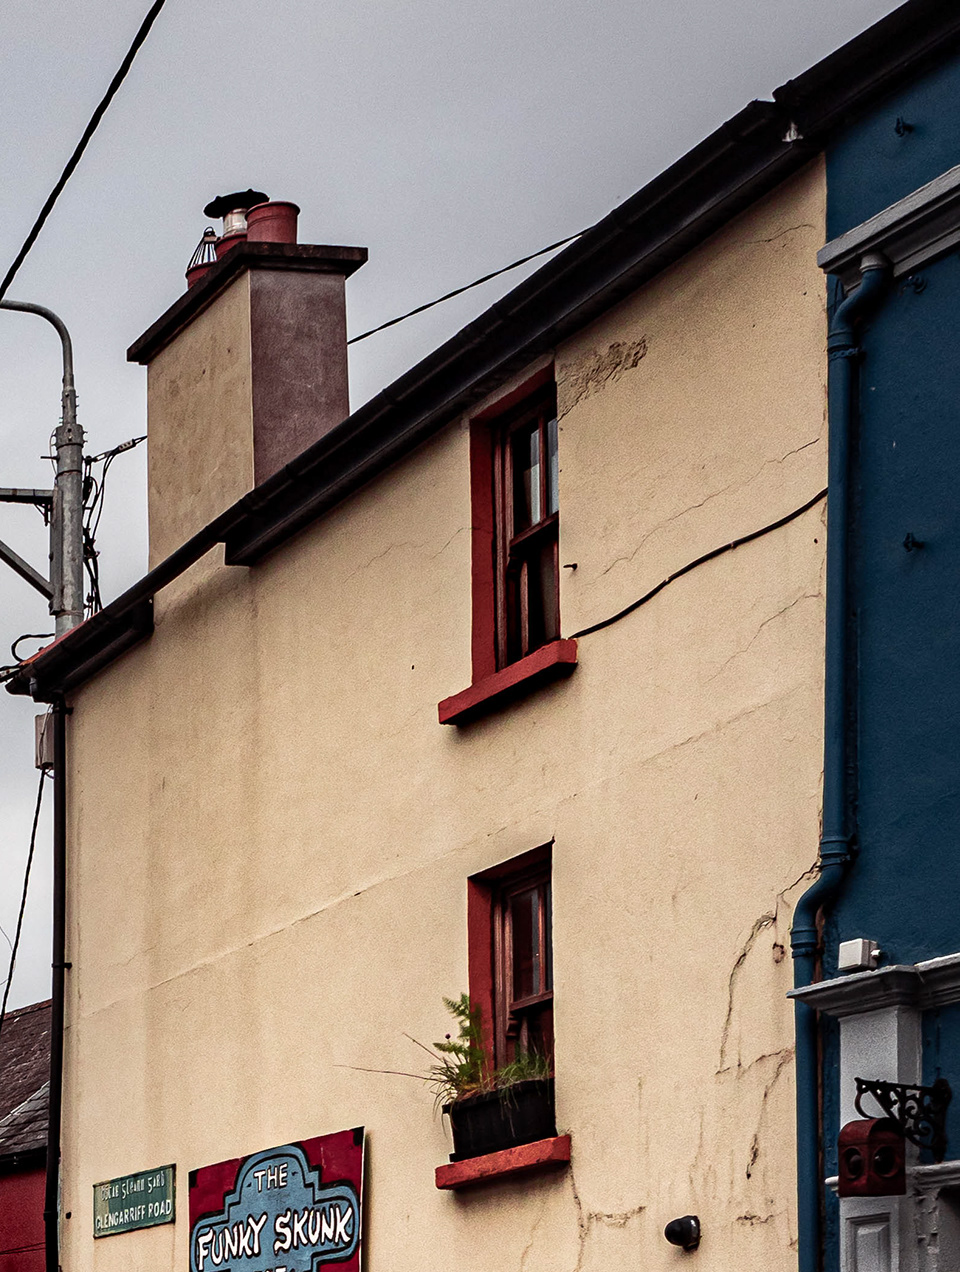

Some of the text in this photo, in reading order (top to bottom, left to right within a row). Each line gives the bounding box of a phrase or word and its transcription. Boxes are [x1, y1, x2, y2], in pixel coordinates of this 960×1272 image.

[254, 1163, 288, 1192] THE
[95, 1199, 172, 1230] GLENGARRIFF ROAD
[197, 1206, 353, 1271] FUNKY SKUNK
